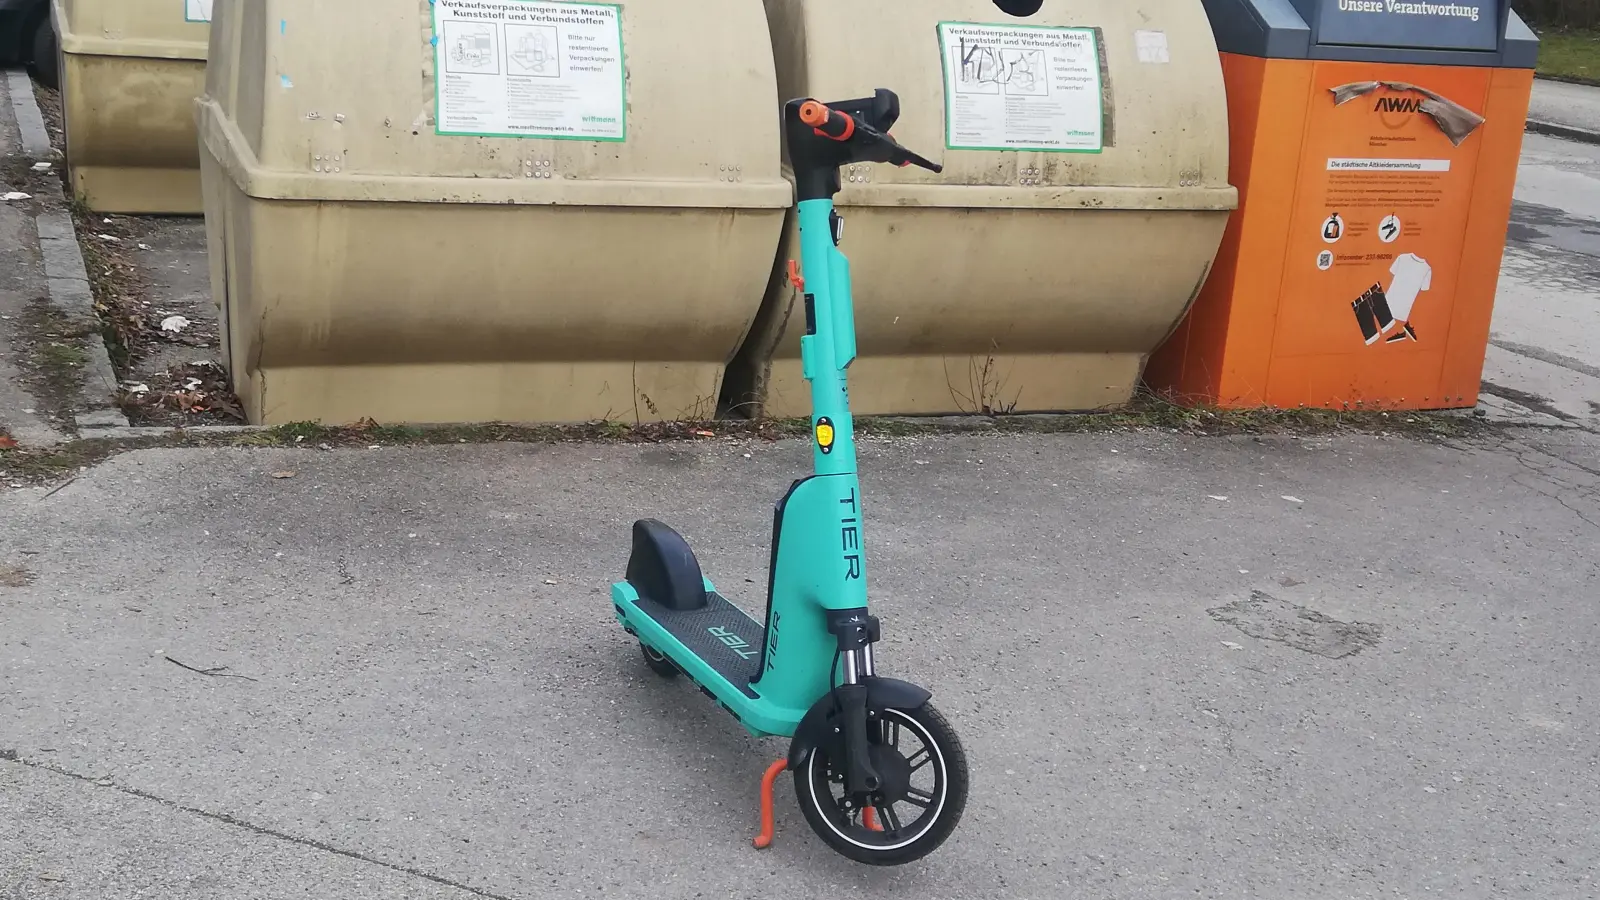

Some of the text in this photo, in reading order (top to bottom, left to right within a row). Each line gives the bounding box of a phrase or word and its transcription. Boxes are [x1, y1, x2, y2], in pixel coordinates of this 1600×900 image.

[442, 0, 557, 14] Verkaufsverpackungen
[581, 9, 614, 18] Metall,
[453, 10, 505, 19] Kunststoff
[530, 14, 604, 25] Verbundstoffen
[1339, 0, 1479, 21] Unsere Verantwortung
[949, 28, 1044, 39] Verkaufsverpackungen
[569, 54, 615, 63] Verpackungen
[1374, 97, 1421, 113] AWM
[839, 487, 861, 581] TIER
[707, 625, 759, 660] TIER
[767, 610, 781, 673] TIER
